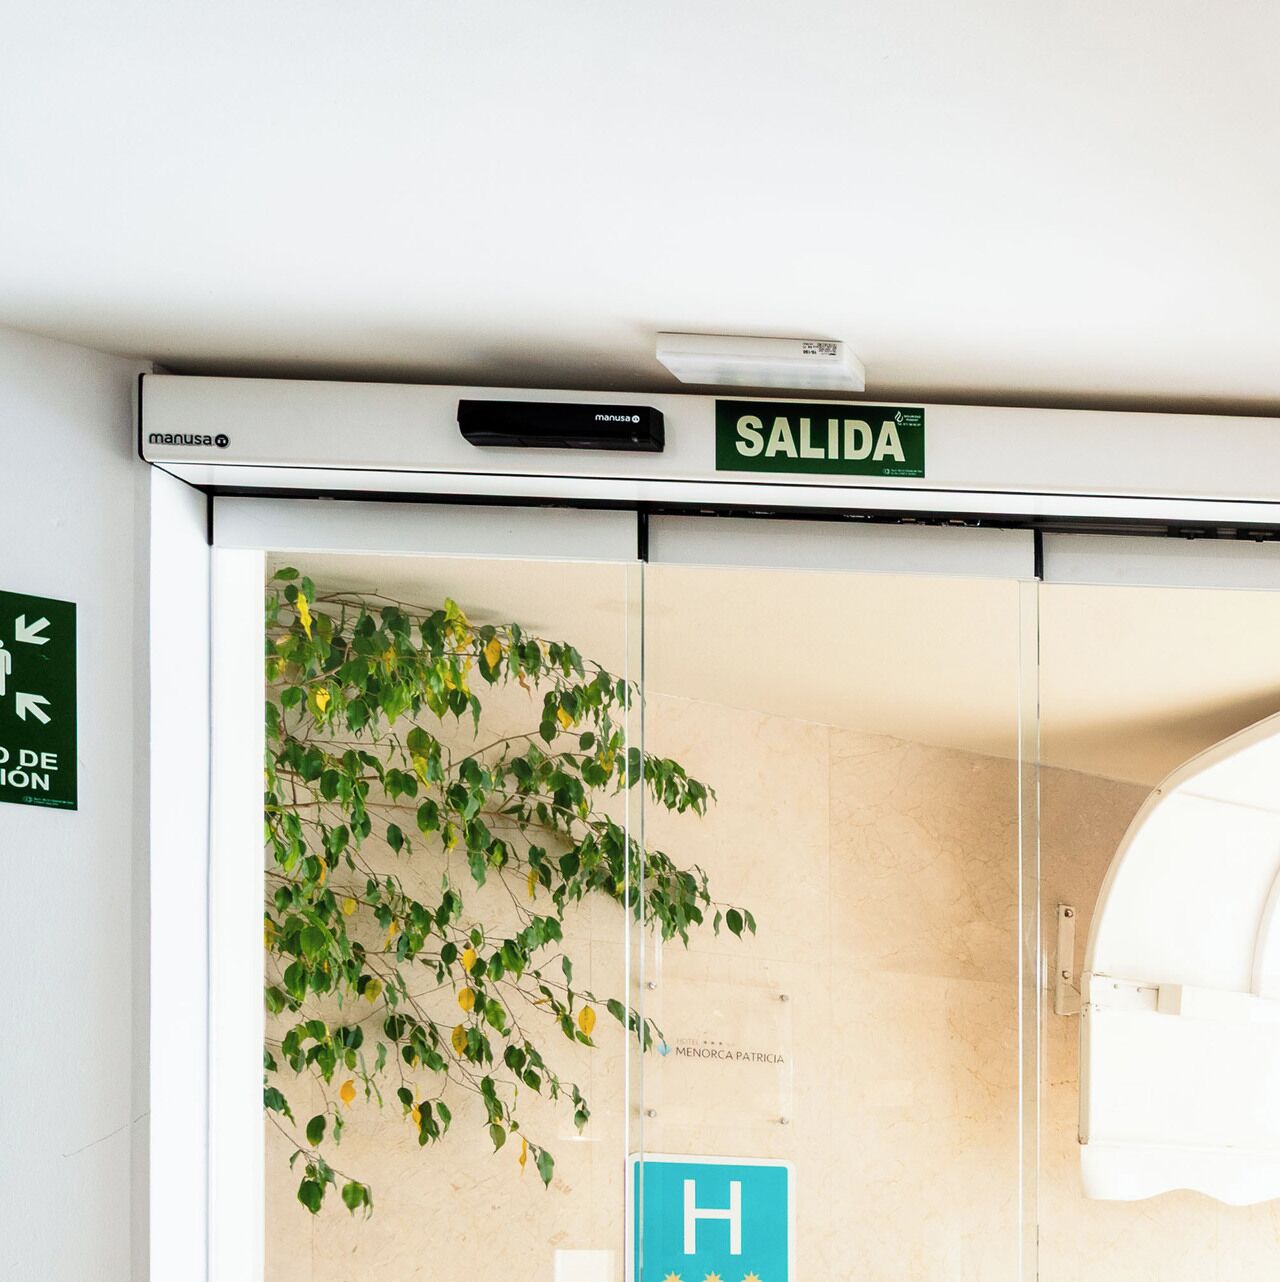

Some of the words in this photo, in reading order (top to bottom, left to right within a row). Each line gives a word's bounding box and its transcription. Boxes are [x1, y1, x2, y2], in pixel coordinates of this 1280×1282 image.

[594, 414, 631, 422] manusa
[148, 433, 212, 446] manusa
[735, 415, 906, 462] SALIDA
[19, 749, 59, 771] DE
[675, 1046, 733, 1061] MENORCA
[736, 1051, 785, 1064] PATRICIA
[683, 1179, 742, 1255] H
